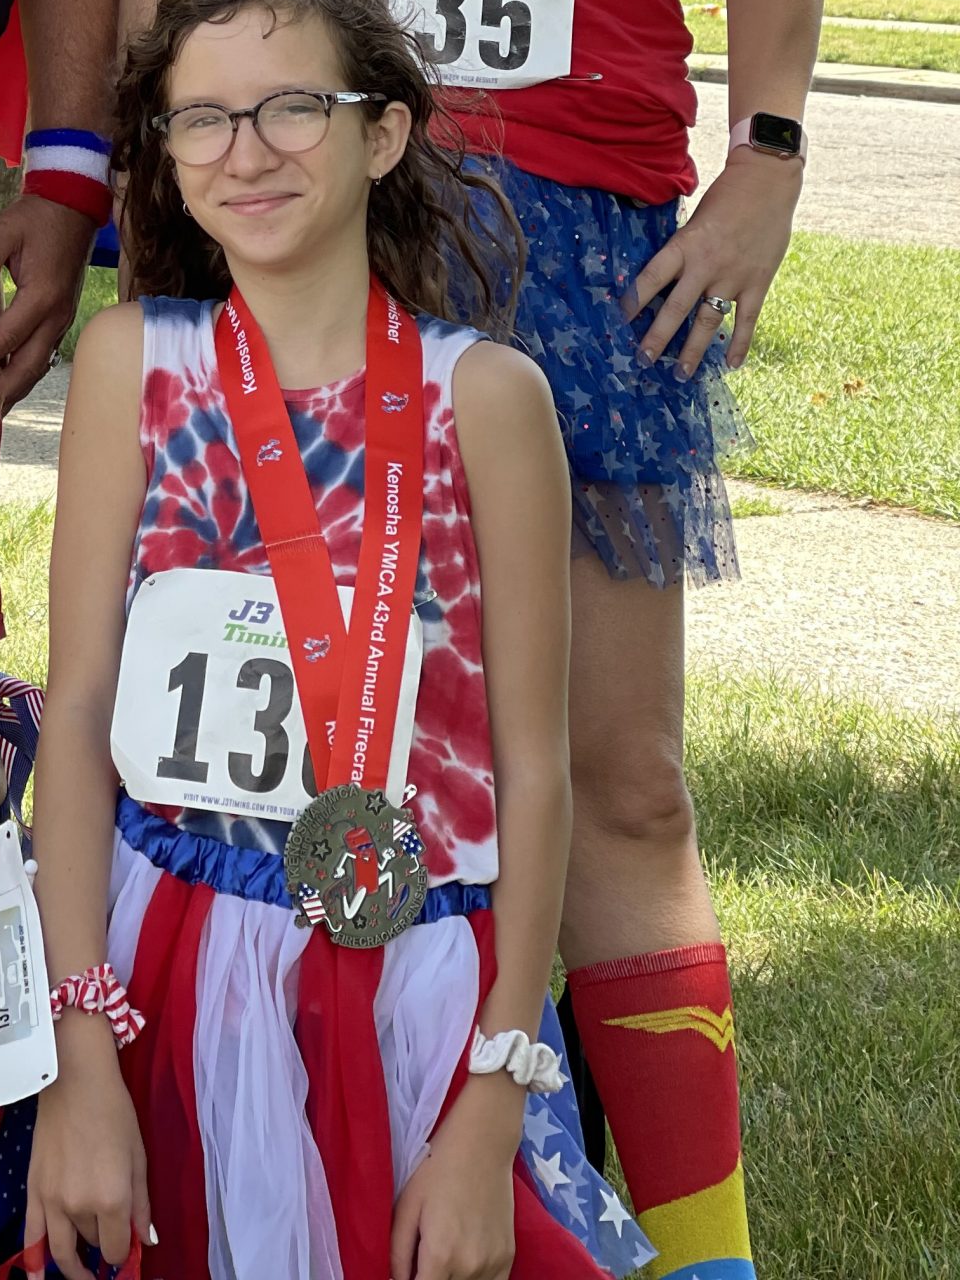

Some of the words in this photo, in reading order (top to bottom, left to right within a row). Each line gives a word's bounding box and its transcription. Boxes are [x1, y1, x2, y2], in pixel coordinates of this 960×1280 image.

[236, 329, 258, 395] Kenosha
[385, 462, 403, 536] Kenosha
[376, 541, 400, 598] YMCA
[228, 599, 275, 625] J3
[370, 601, 391, 643] 43rd
[360, 645, 385, 713] Annual
[156, 651, 321, 798] 13
[288, 803, 324, 879] KENOSHA
[318, 784, 360, 809] YMCA
[331, 917, 408, 948] FIRECRACKER
[402, 865, 429, 921] FINISHER
